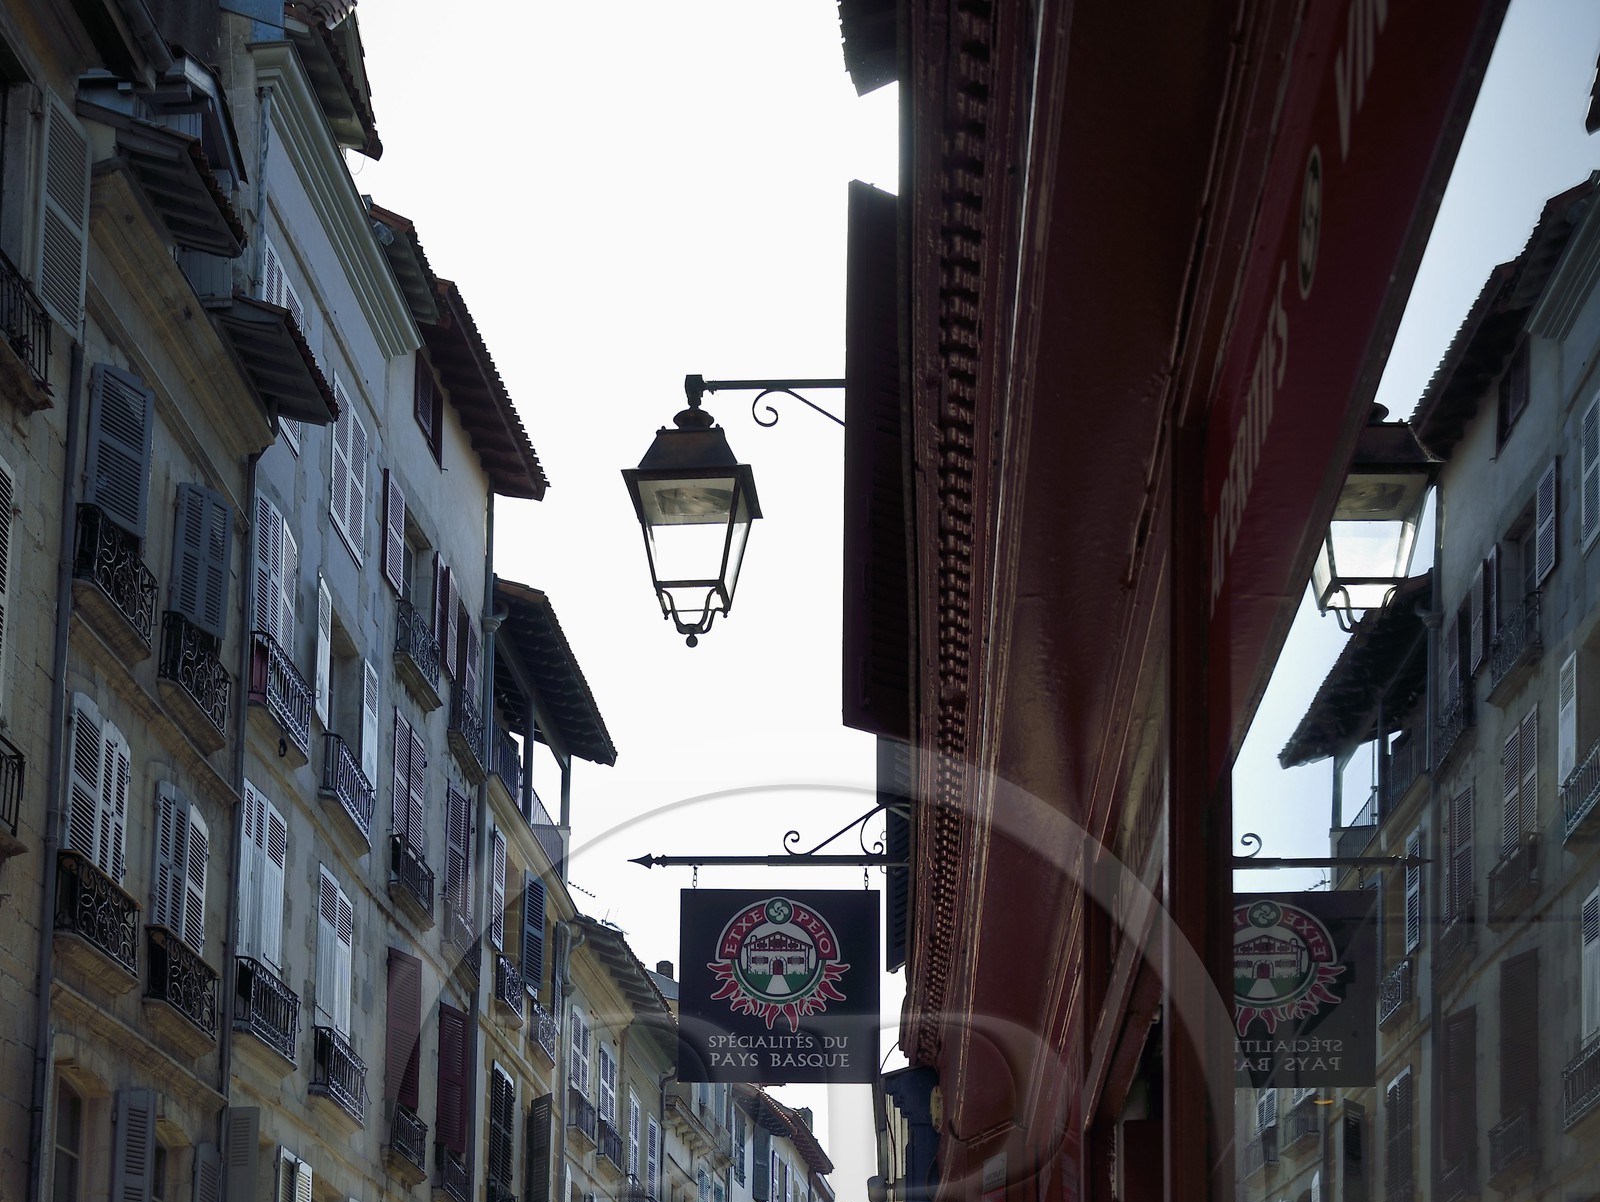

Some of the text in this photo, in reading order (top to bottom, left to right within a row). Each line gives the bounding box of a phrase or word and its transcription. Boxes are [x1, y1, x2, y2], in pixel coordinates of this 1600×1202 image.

[1210, 260, 1289, 621] APERITIFS
[724, 909, 832, 955] ETXE PEIO
[708, 1032, 848, 1049] SPÉCIALITÉS DU
[710, 1053, 850, 1068] PAYS BASQUE
